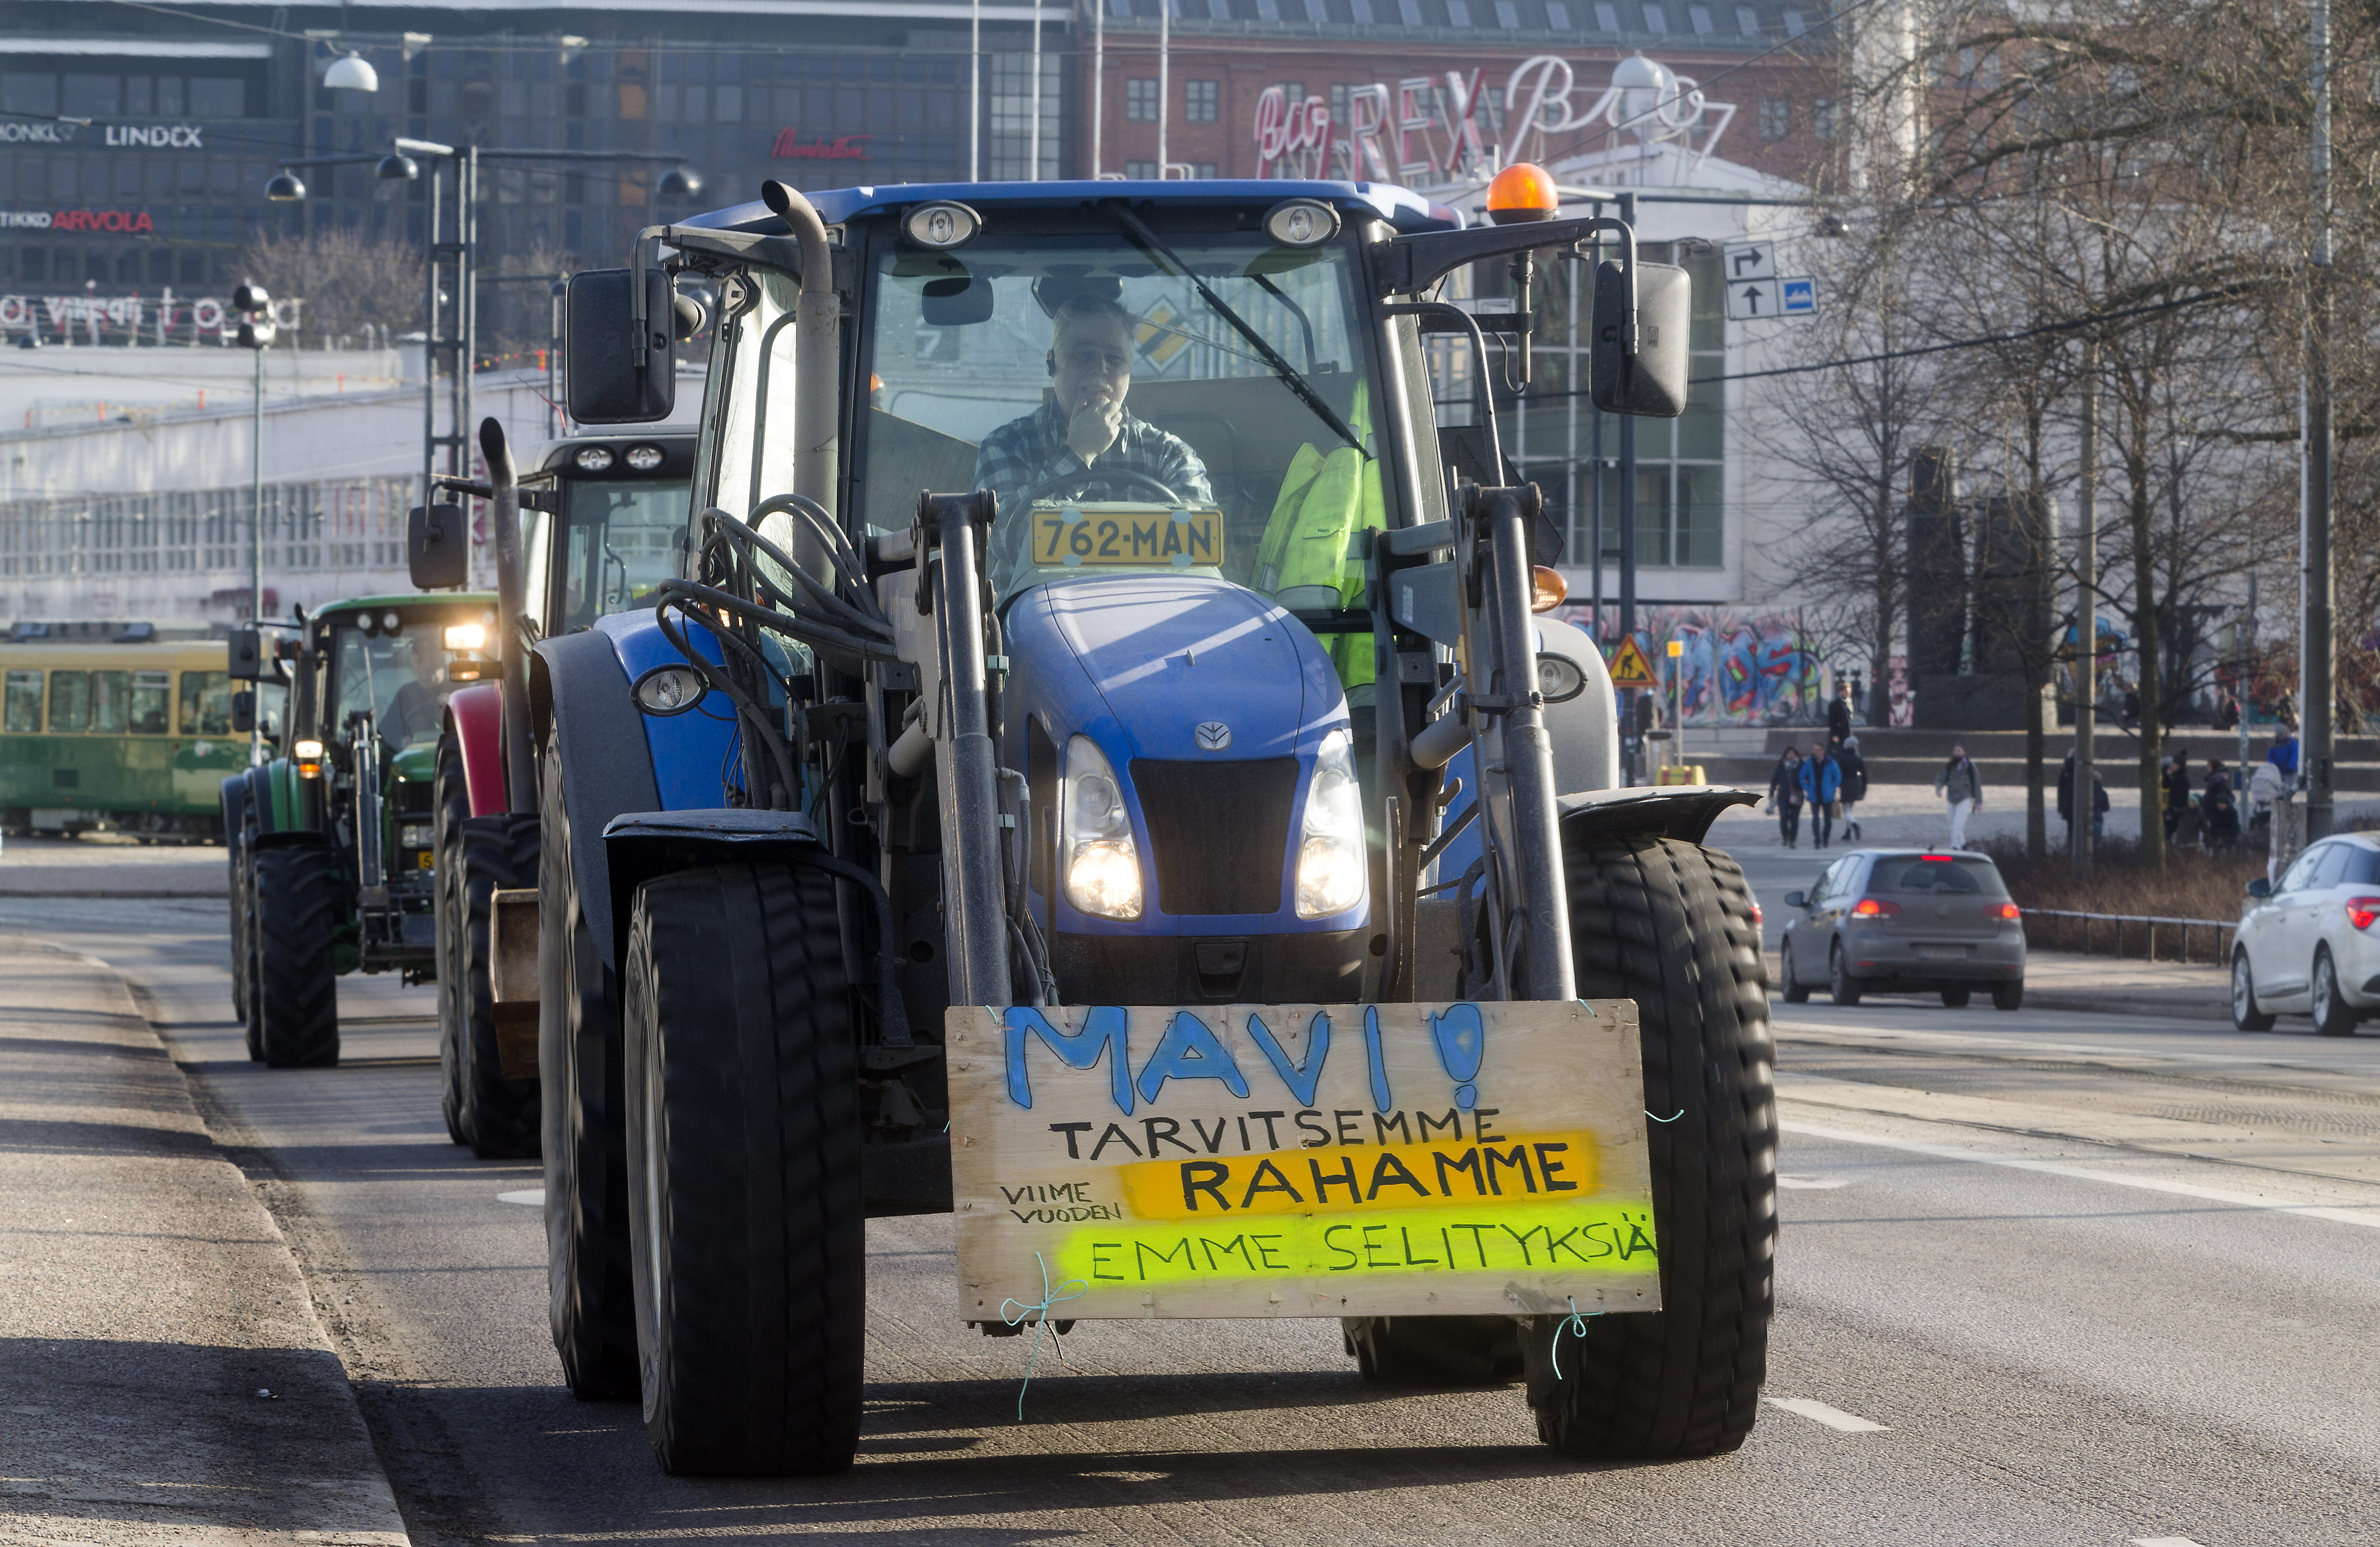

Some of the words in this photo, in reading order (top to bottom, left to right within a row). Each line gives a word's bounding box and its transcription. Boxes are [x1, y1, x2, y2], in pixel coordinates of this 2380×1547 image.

[106, 125, 203, 148] LINDEX
[1350, 67, 1487, 182] REX
[51, 210, 153, 232] ARVOLA
[1043, 519, 1212, 557] 762-MAN
[1048, 1108, 1506, 1161] TARVITSEMME
[999, 1182, 1093, 1205] VIIME
[1180, 1142, 1578, 1211] RAHAMME
[1010, 1202, 1122, 1223] VUODEN
[1092, 1234, 1290, 1281] EMME
[1324, 1212, 1658, 1271] SELITYKSIÄ
